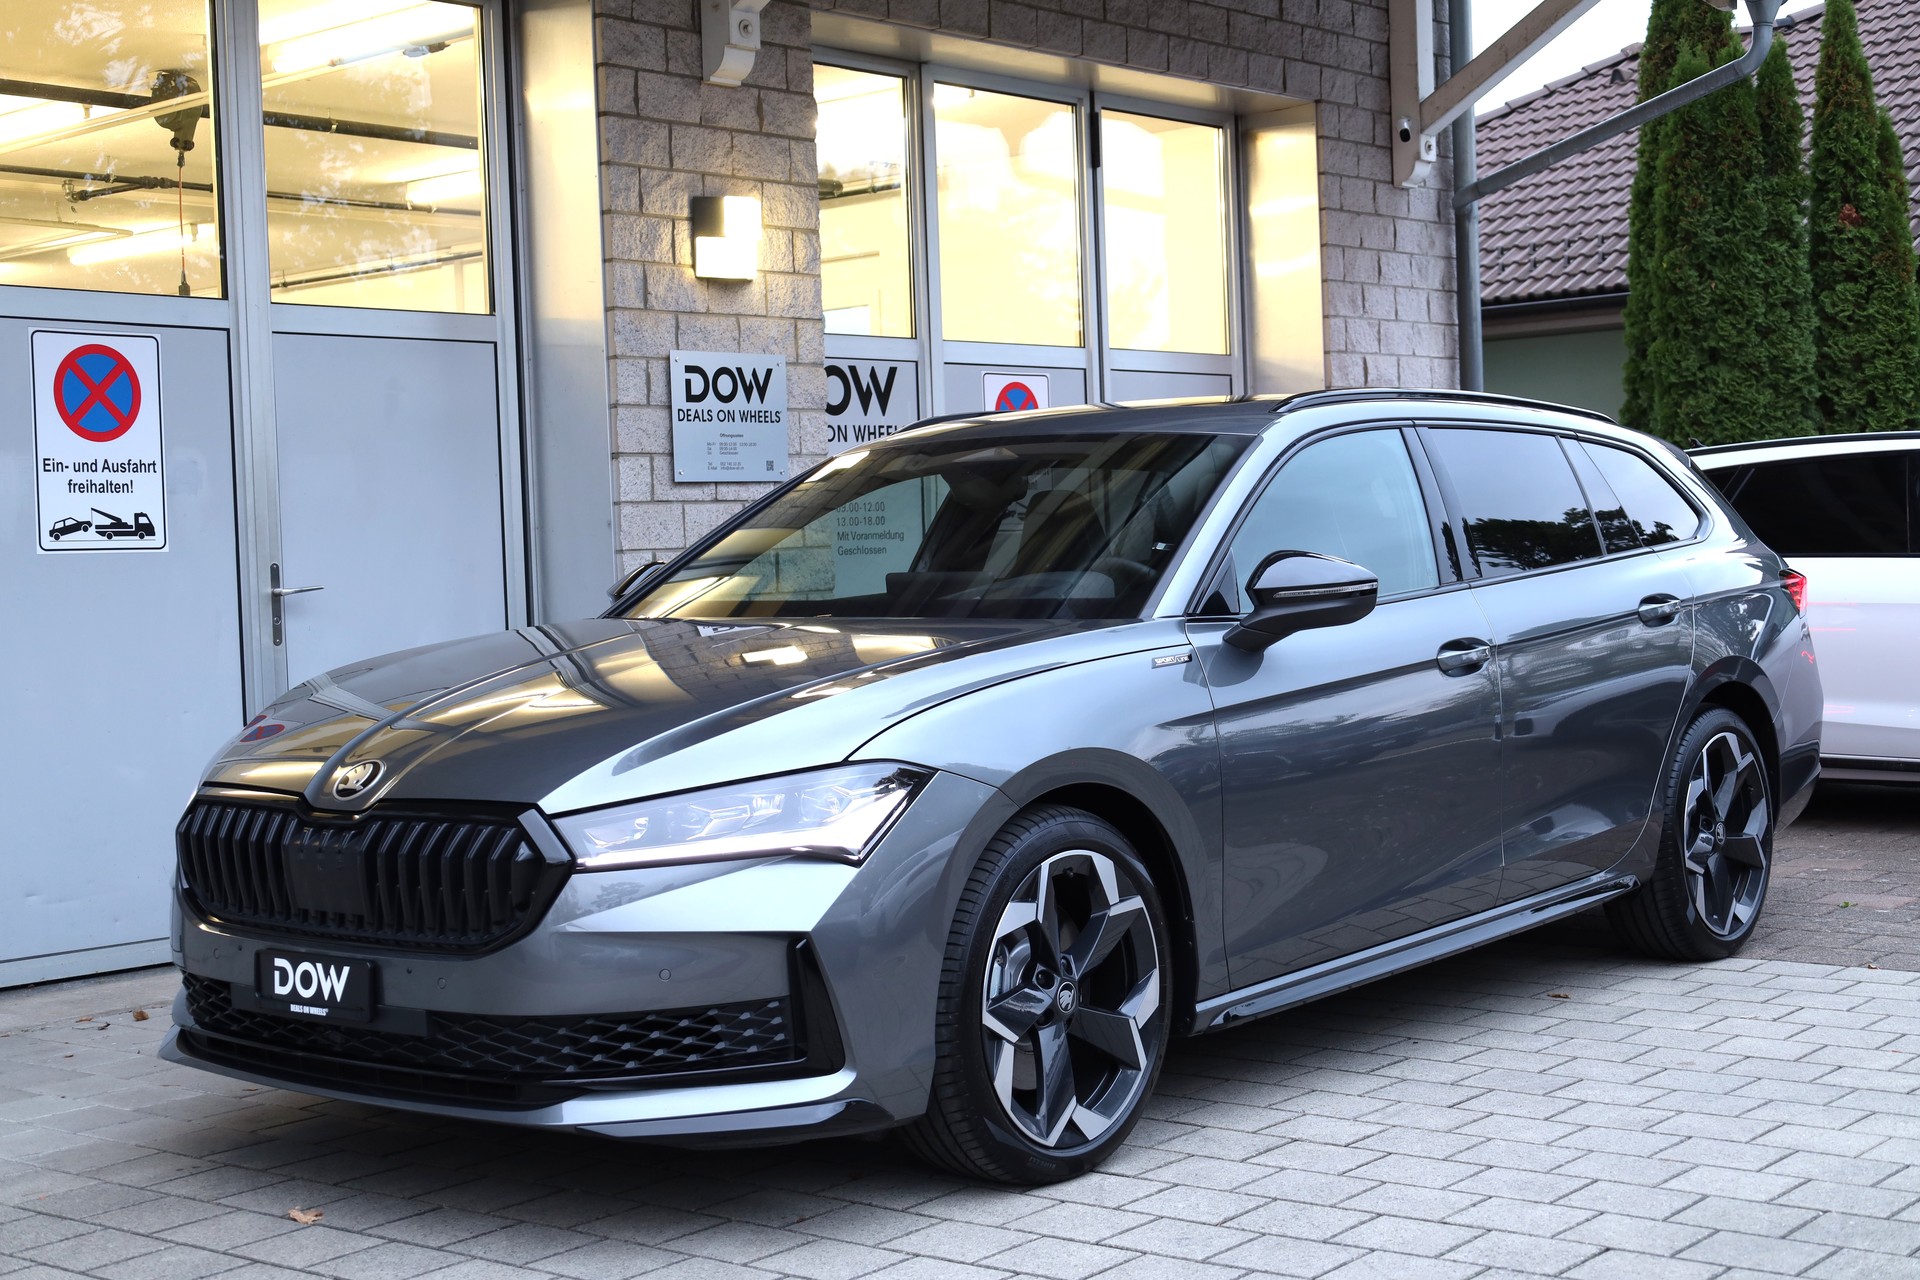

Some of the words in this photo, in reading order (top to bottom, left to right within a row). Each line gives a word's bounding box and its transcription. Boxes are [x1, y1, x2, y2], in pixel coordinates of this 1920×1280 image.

[684, 365, 773, 404] DOW
[824, 365, 898, 416] OW
[677, 408, 713, 422] DEALS
[717, 410, 735, 423] ON
[739, 410, 782, 424] WHEELS
[43, 458, 69, 472] Ein-
[73, 459, 98, 473] und
[102, 459, 157, 473] Ausfahrt
[67, 479, 133, 493] freihalten!
[837, 516, 886, 526] 13.00-18.00
[837, 532, 849, 541] Mit
[851, 530, 905, 541] Voranmeldung
[838, 546, 887, 556] Geschlossen
[274, 957, 350, 1002] DOW
[290, 1004, 303, 1013] DEALS
[303, 1006, 310, 1014] ON
